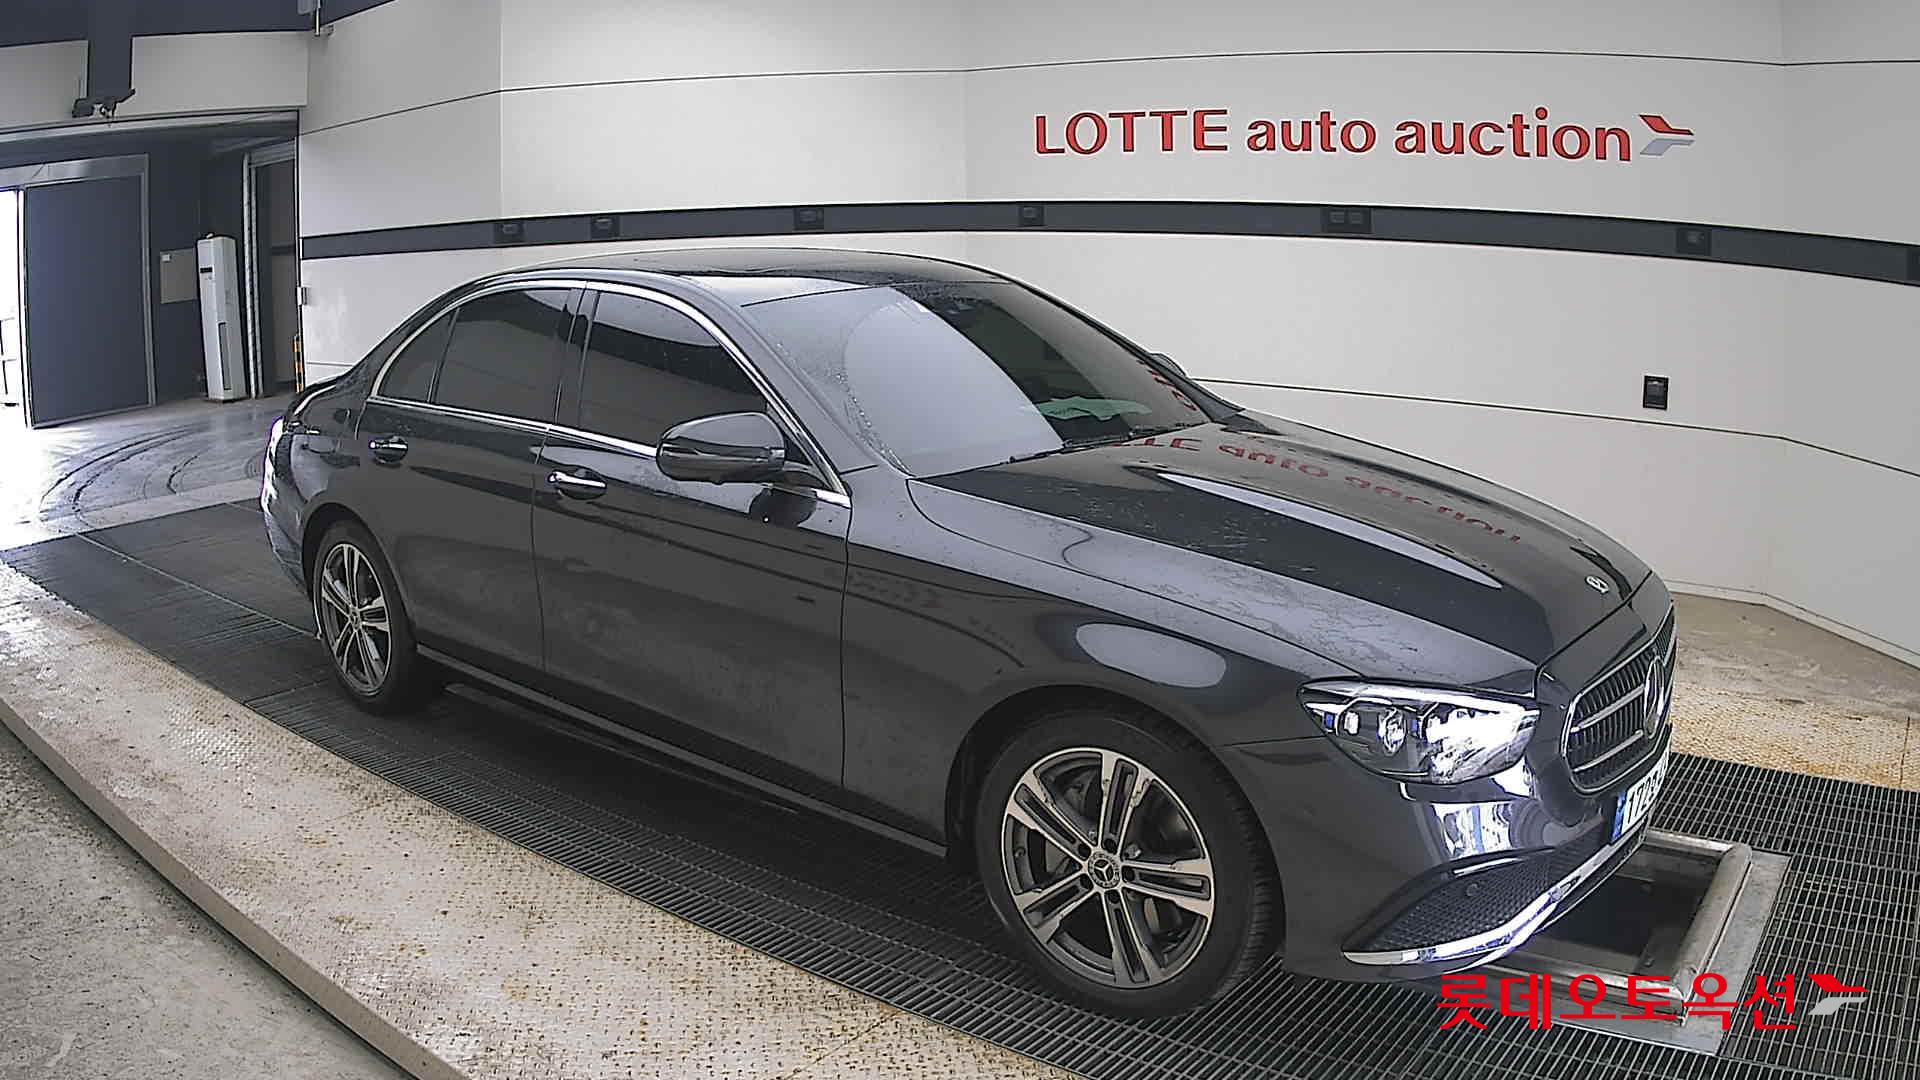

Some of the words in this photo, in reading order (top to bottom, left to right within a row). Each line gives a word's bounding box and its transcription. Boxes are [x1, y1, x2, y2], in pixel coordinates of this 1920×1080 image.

[1035, 109, 1228, 155] LOTTE
[1246, 111, 1377, 154] auto
[1394, 107, 1632, 163] auction
